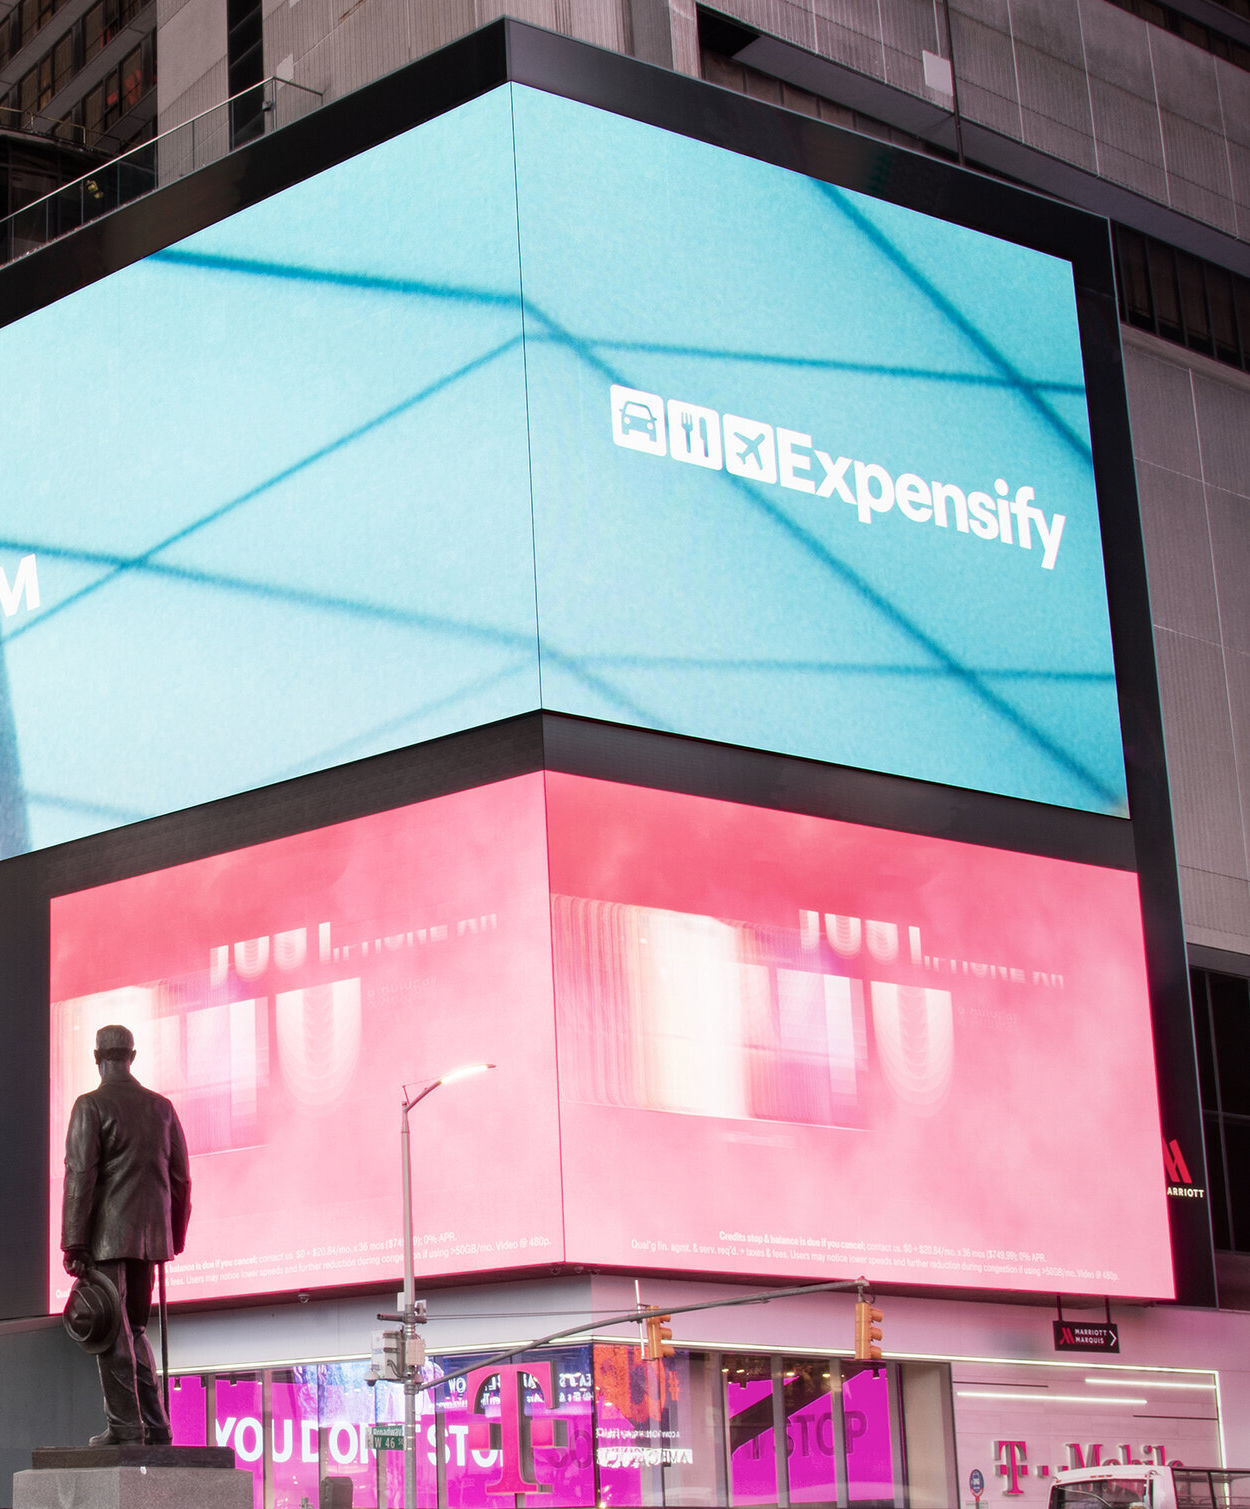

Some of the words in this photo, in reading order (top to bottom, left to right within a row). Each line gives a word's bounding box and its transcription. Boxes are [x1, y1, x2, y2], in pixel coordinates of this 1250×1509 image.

[776, 427, 1067, 570] Expensify
[1166, 1187, 1205, 1198] ARRIOTT
[1074, 1328, 1107, 1336] MARRIOTT
[215, 1416, 293, 1463] YOU
[427, 1424, 504, 1468] STO
[374, 1437, 382, 1448] W
[385, 1437, 395, 1449] 46
